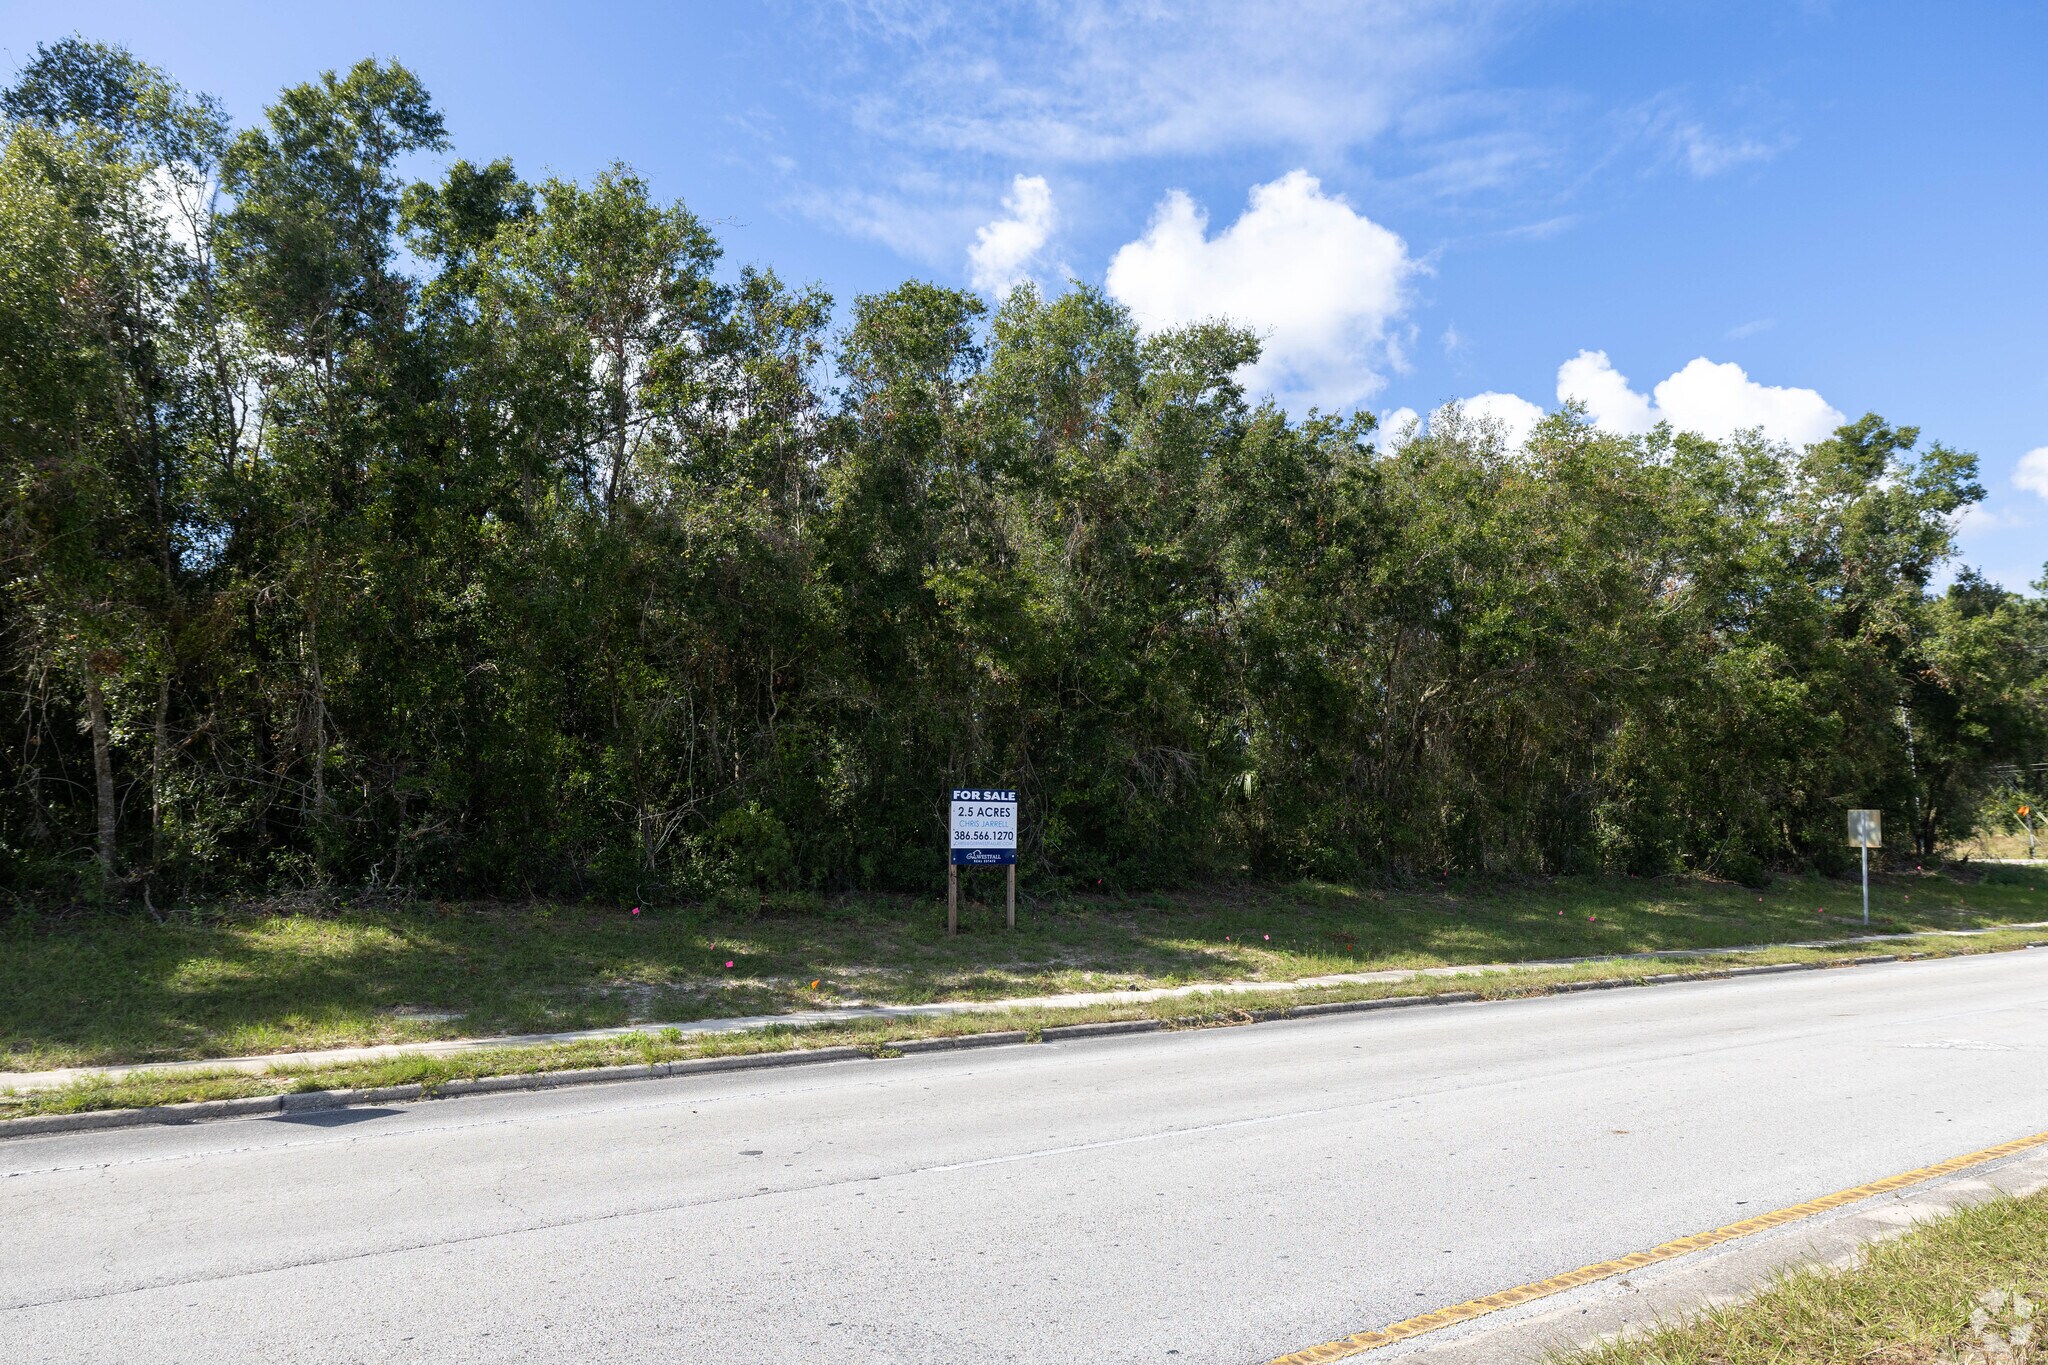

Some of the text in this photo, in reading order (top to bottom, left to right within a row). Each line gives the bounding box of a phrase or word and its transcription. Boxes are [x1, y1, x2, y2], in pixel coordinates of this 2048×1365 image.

[953, 790, 1016, 801] FOR SALE
[958, 806, 1010, 818] 2.5 ACRES
[959, 820, 1009, 828] CHRIS JARRELL
[954, 830, 1014, 841] 386.566.1270
